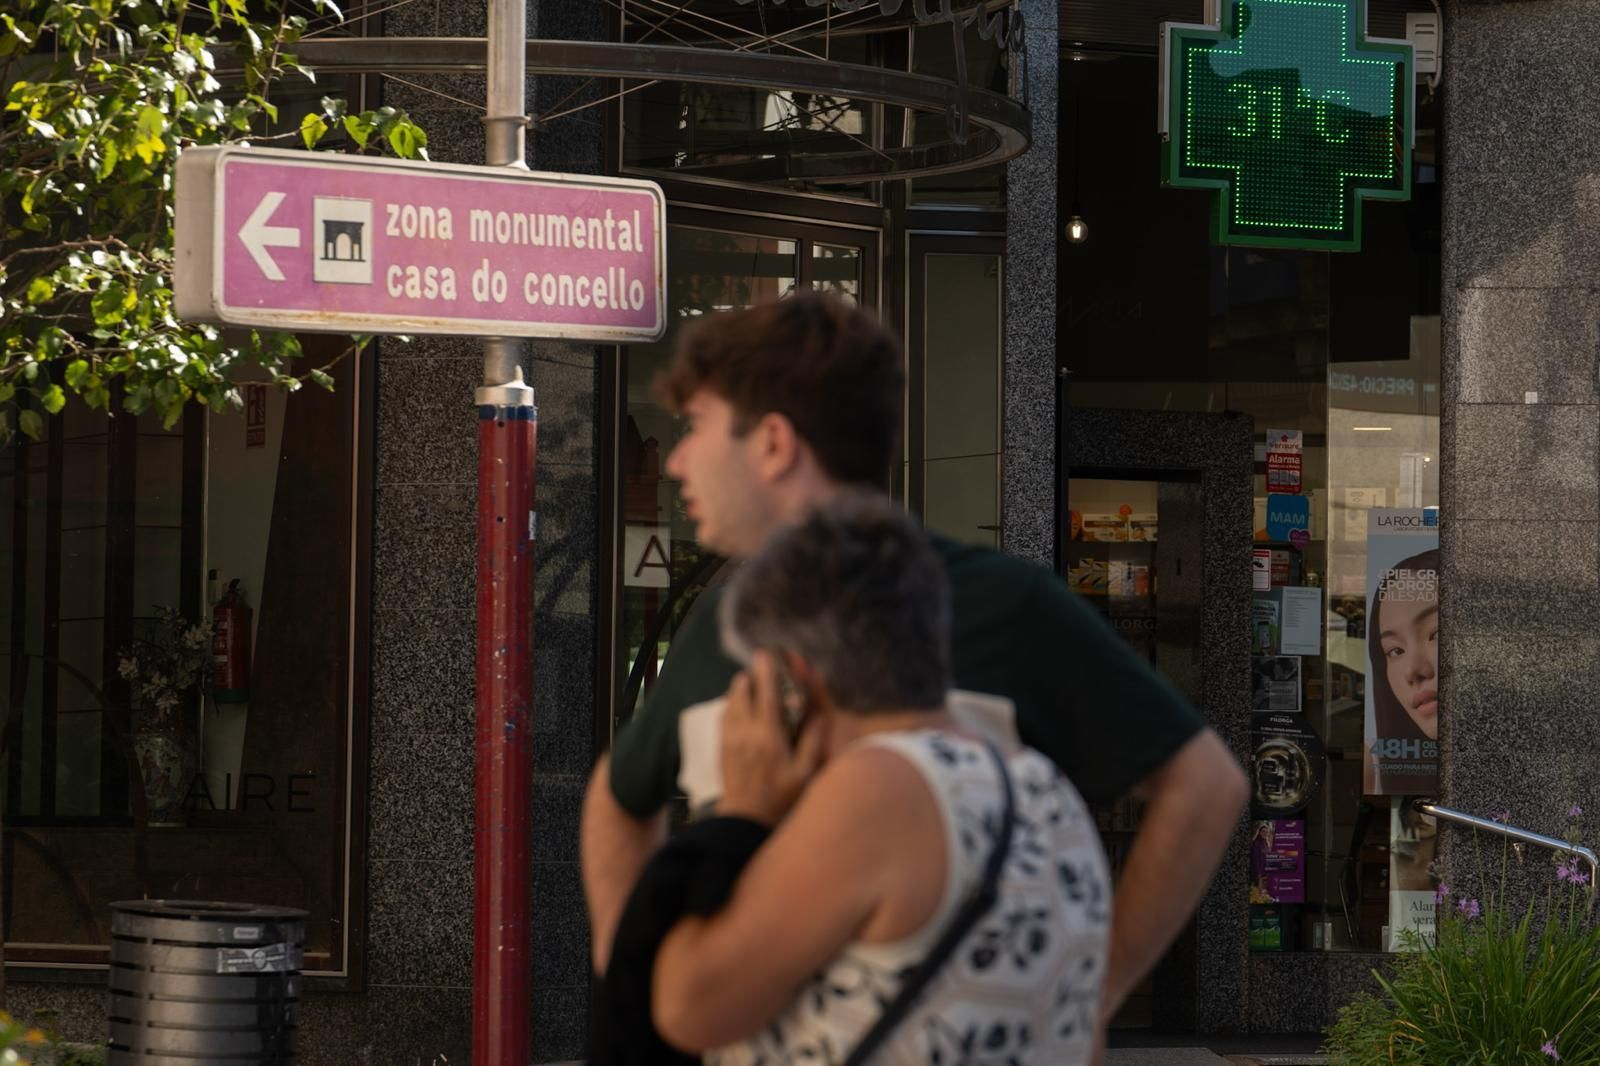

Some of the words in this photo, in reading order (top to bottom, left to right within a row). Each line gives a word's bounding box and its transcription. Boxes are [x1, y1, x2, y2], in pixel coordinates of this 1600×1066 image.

[1227, 83, 1350, 143] 31°C
[386, 203, 453, 240] zona
[470, 208, 643, 252] monumental
[387, 264, 457, 301] casa
[472, 258, 508, 303] do
[524, 267, 645, 311] concello
[1269, 454, 1301, 465] Alarma
[1270, 512, 1306, 525] MAM
[1378, 516, 1392, 526] LA
[1379, 581, 1434, 591] ¿POROS
[1379, 591, 1413, 601] DILES
[1370, 738, 1421, 759] 48H
[180, 773, 316, 812] AIRE
